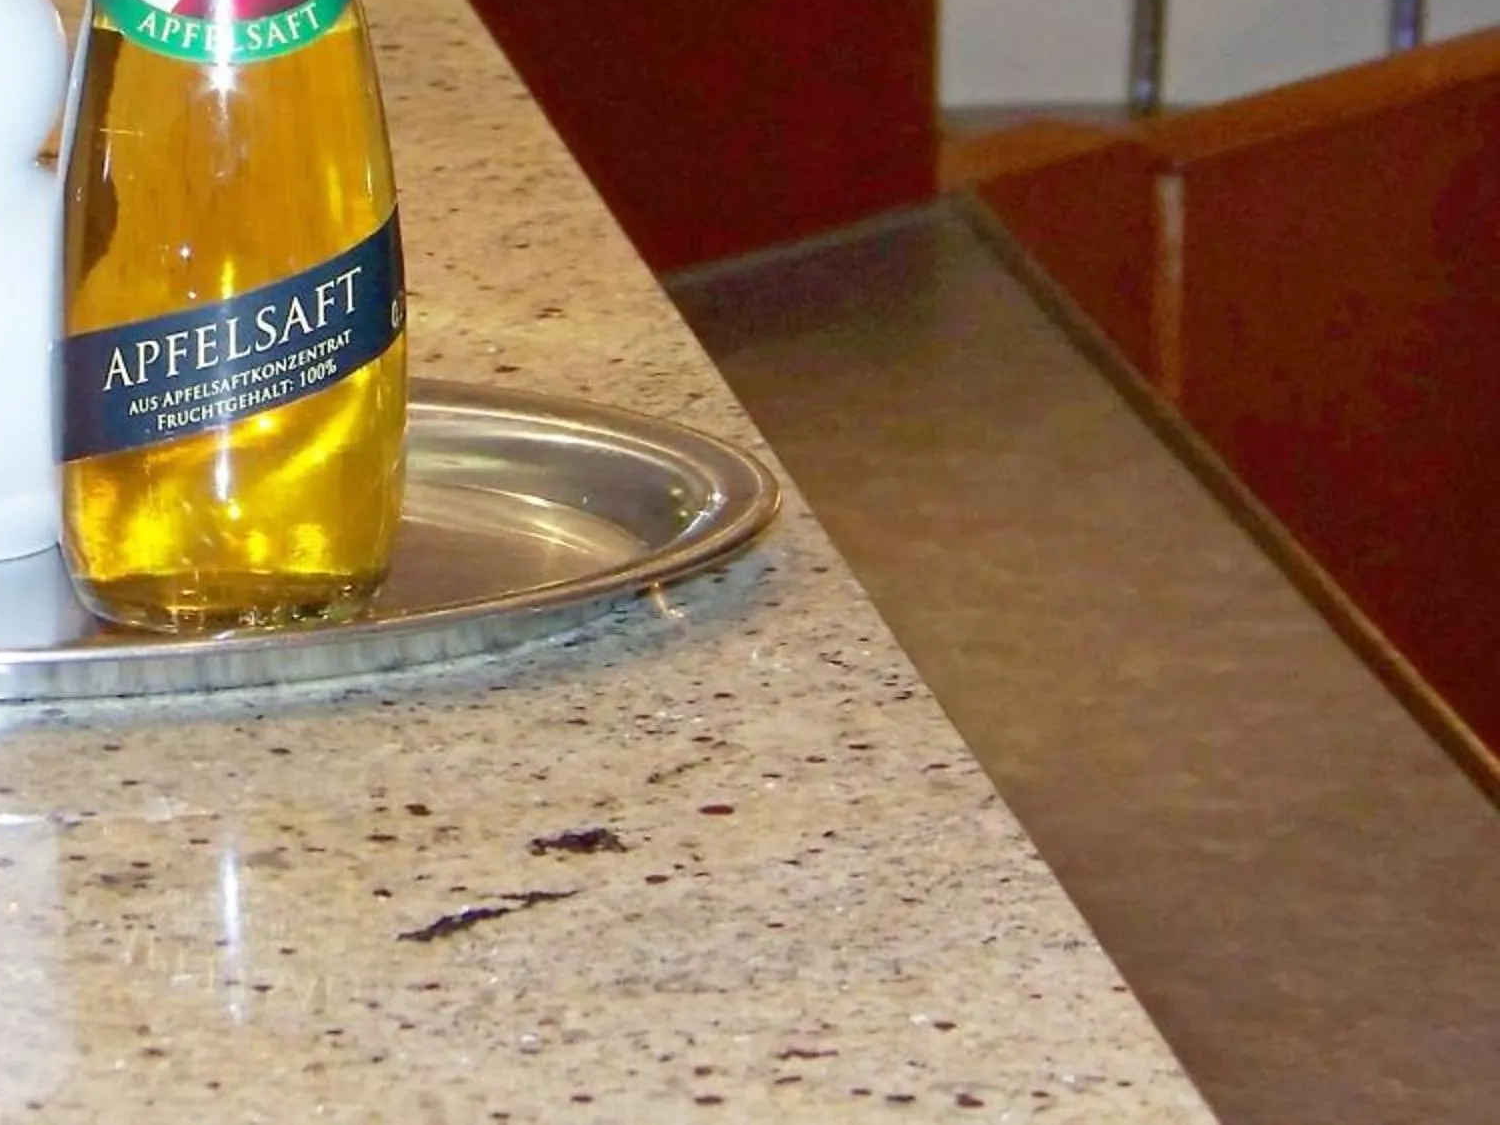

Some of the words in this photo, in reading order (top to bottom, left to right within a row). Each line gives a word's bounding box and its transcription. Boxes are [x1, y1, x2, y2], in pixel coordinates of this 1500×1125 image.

[103, 266, 362, 392] APFELSAFT
[128, 394, 162, 417] AUS
[162, 328, 353, 408] APFELSAFTKONZENTRAT
[156, 379, 295, 431] FRUCHTGEHALT:
[298, 358, 338, 388] 100%
